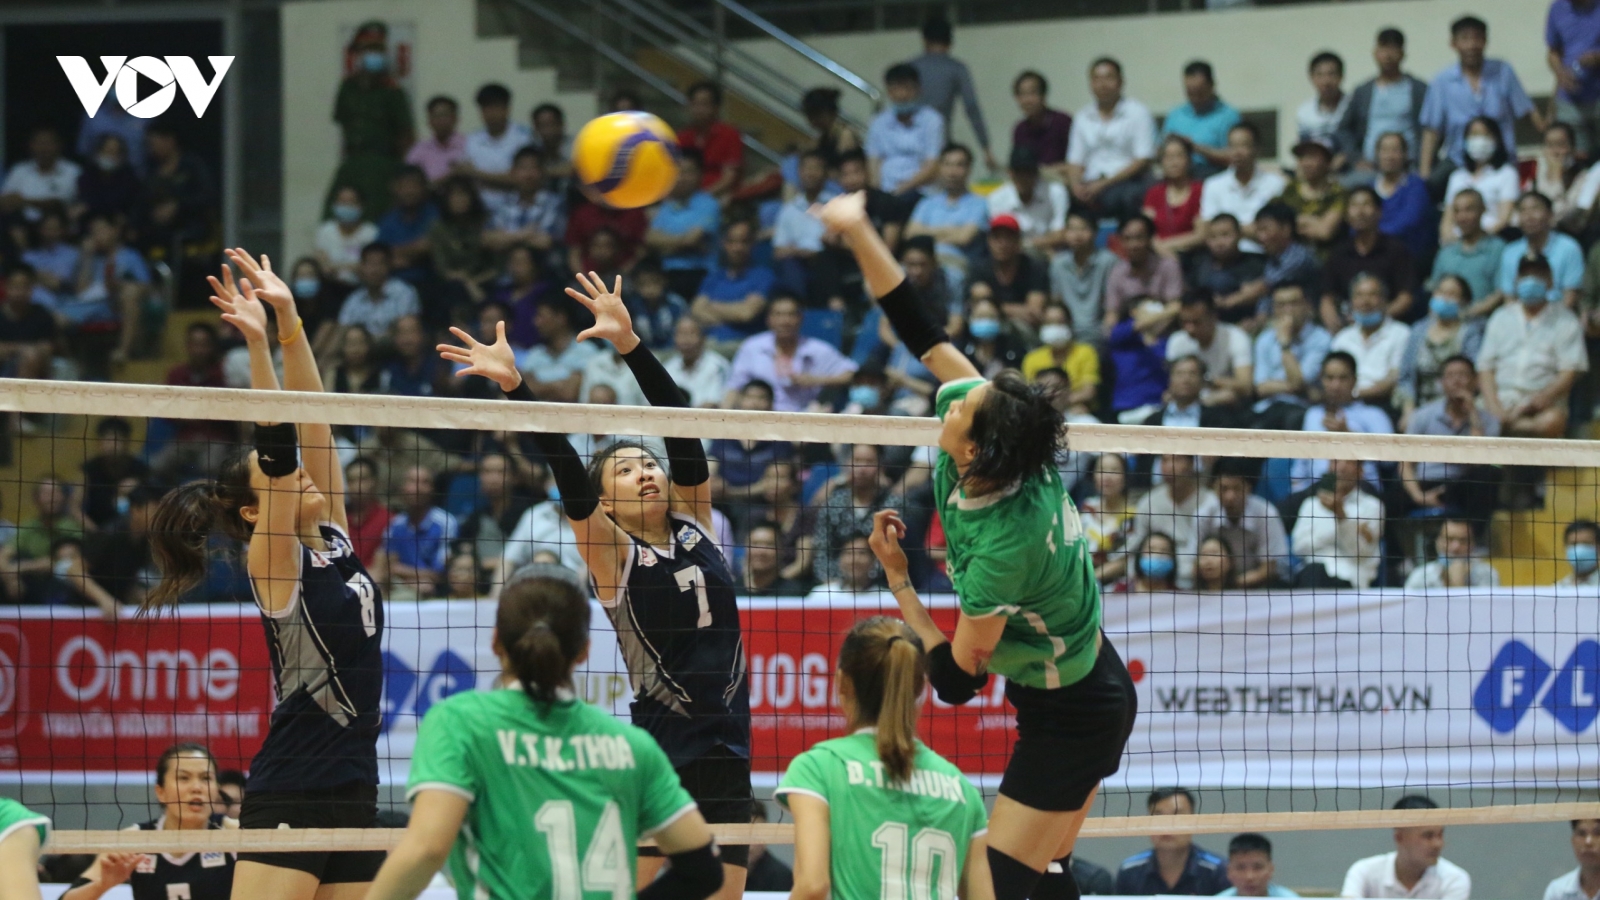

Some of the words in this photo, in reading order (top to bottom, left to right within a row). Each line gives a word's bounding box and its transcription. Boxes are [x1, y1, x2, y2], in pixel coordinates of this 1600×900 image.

[345, 571, 376, 638] 8
[673, 564, 713, 628] 7
[57, 635, 240, 702] Onme
[534, 799, 634, 900] 14
[871, 821, 959, 900] 10
